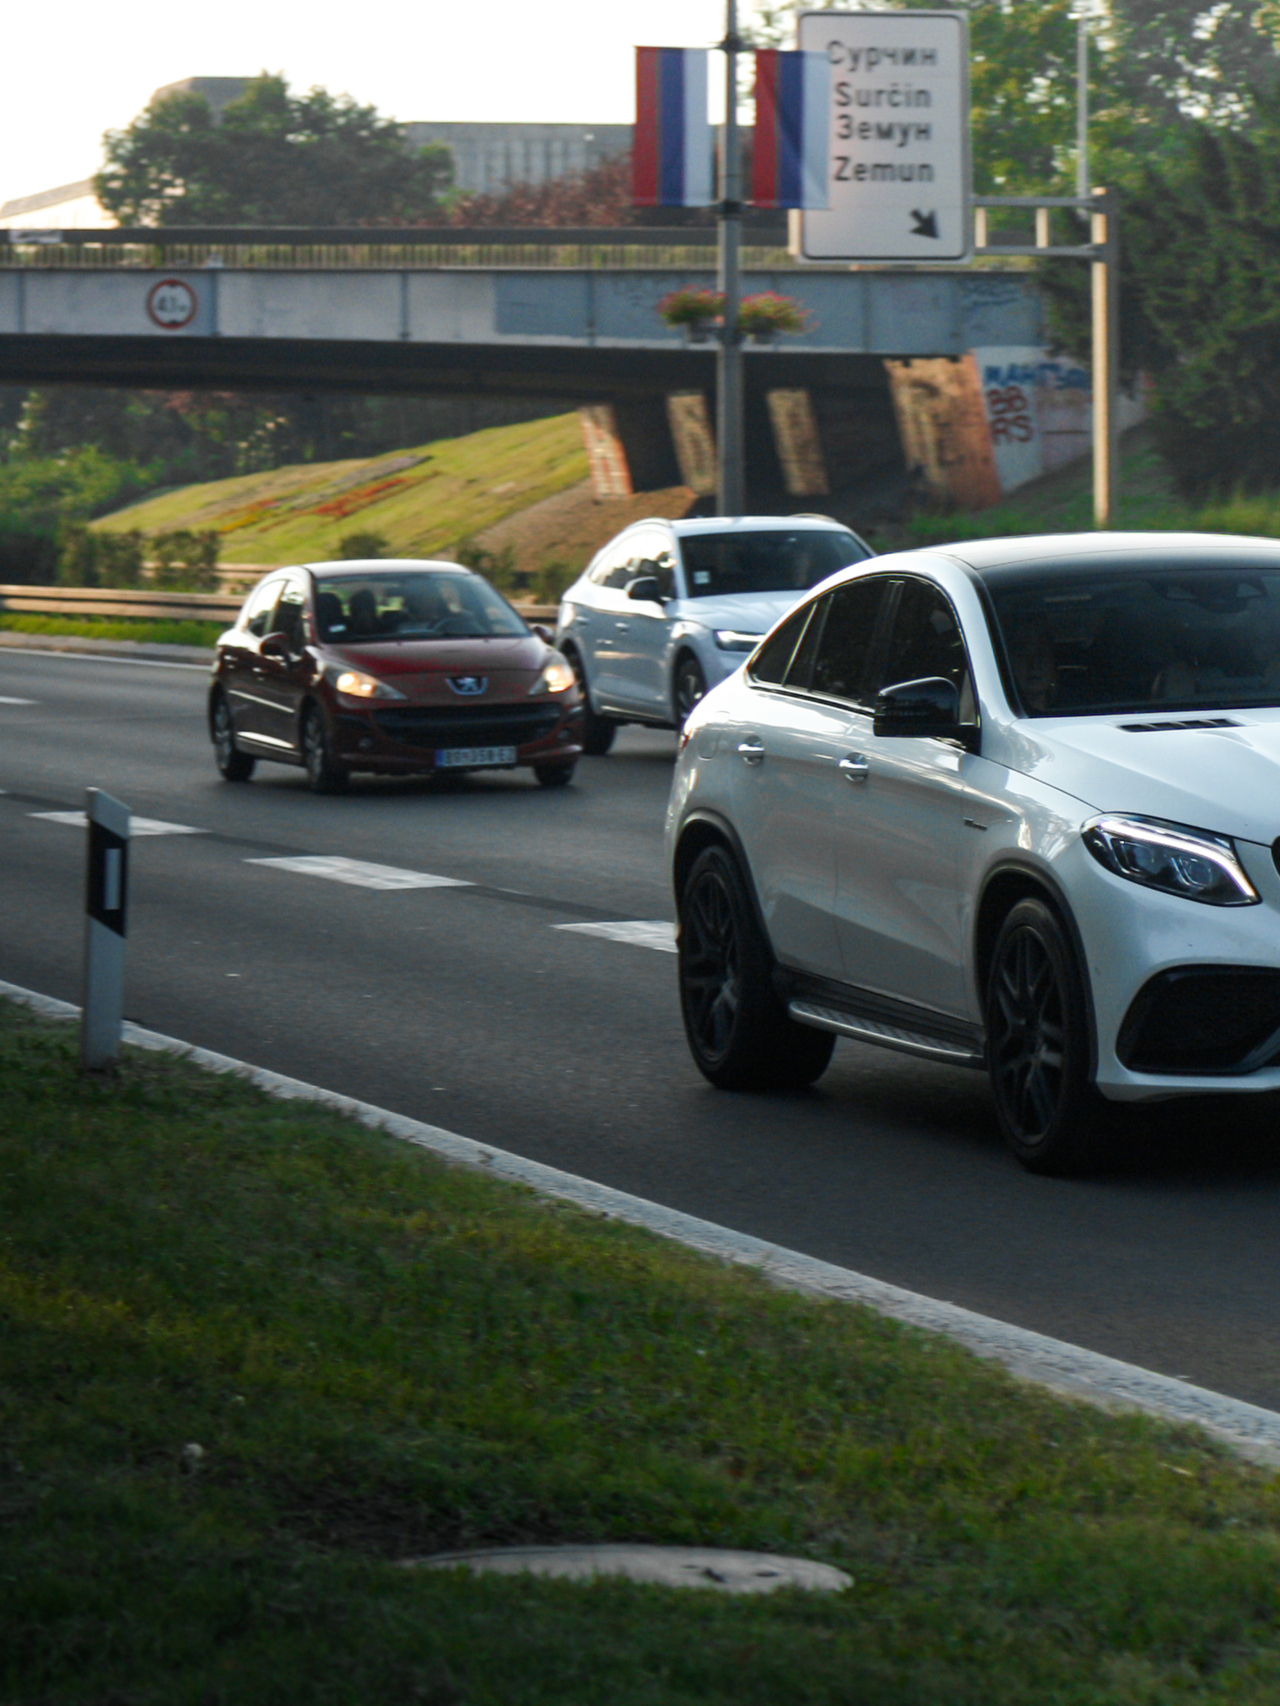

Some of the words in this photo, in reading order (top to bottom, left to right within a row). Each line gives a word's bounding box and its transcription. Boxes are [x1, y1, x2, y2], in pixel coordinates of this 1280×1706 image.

[826, 40, 938, 73] Сурчин
[834, 81, 932, 108] Surčin
[836, 114, 932, 148] Земун
[833, 155, 936, 183] Zemun
